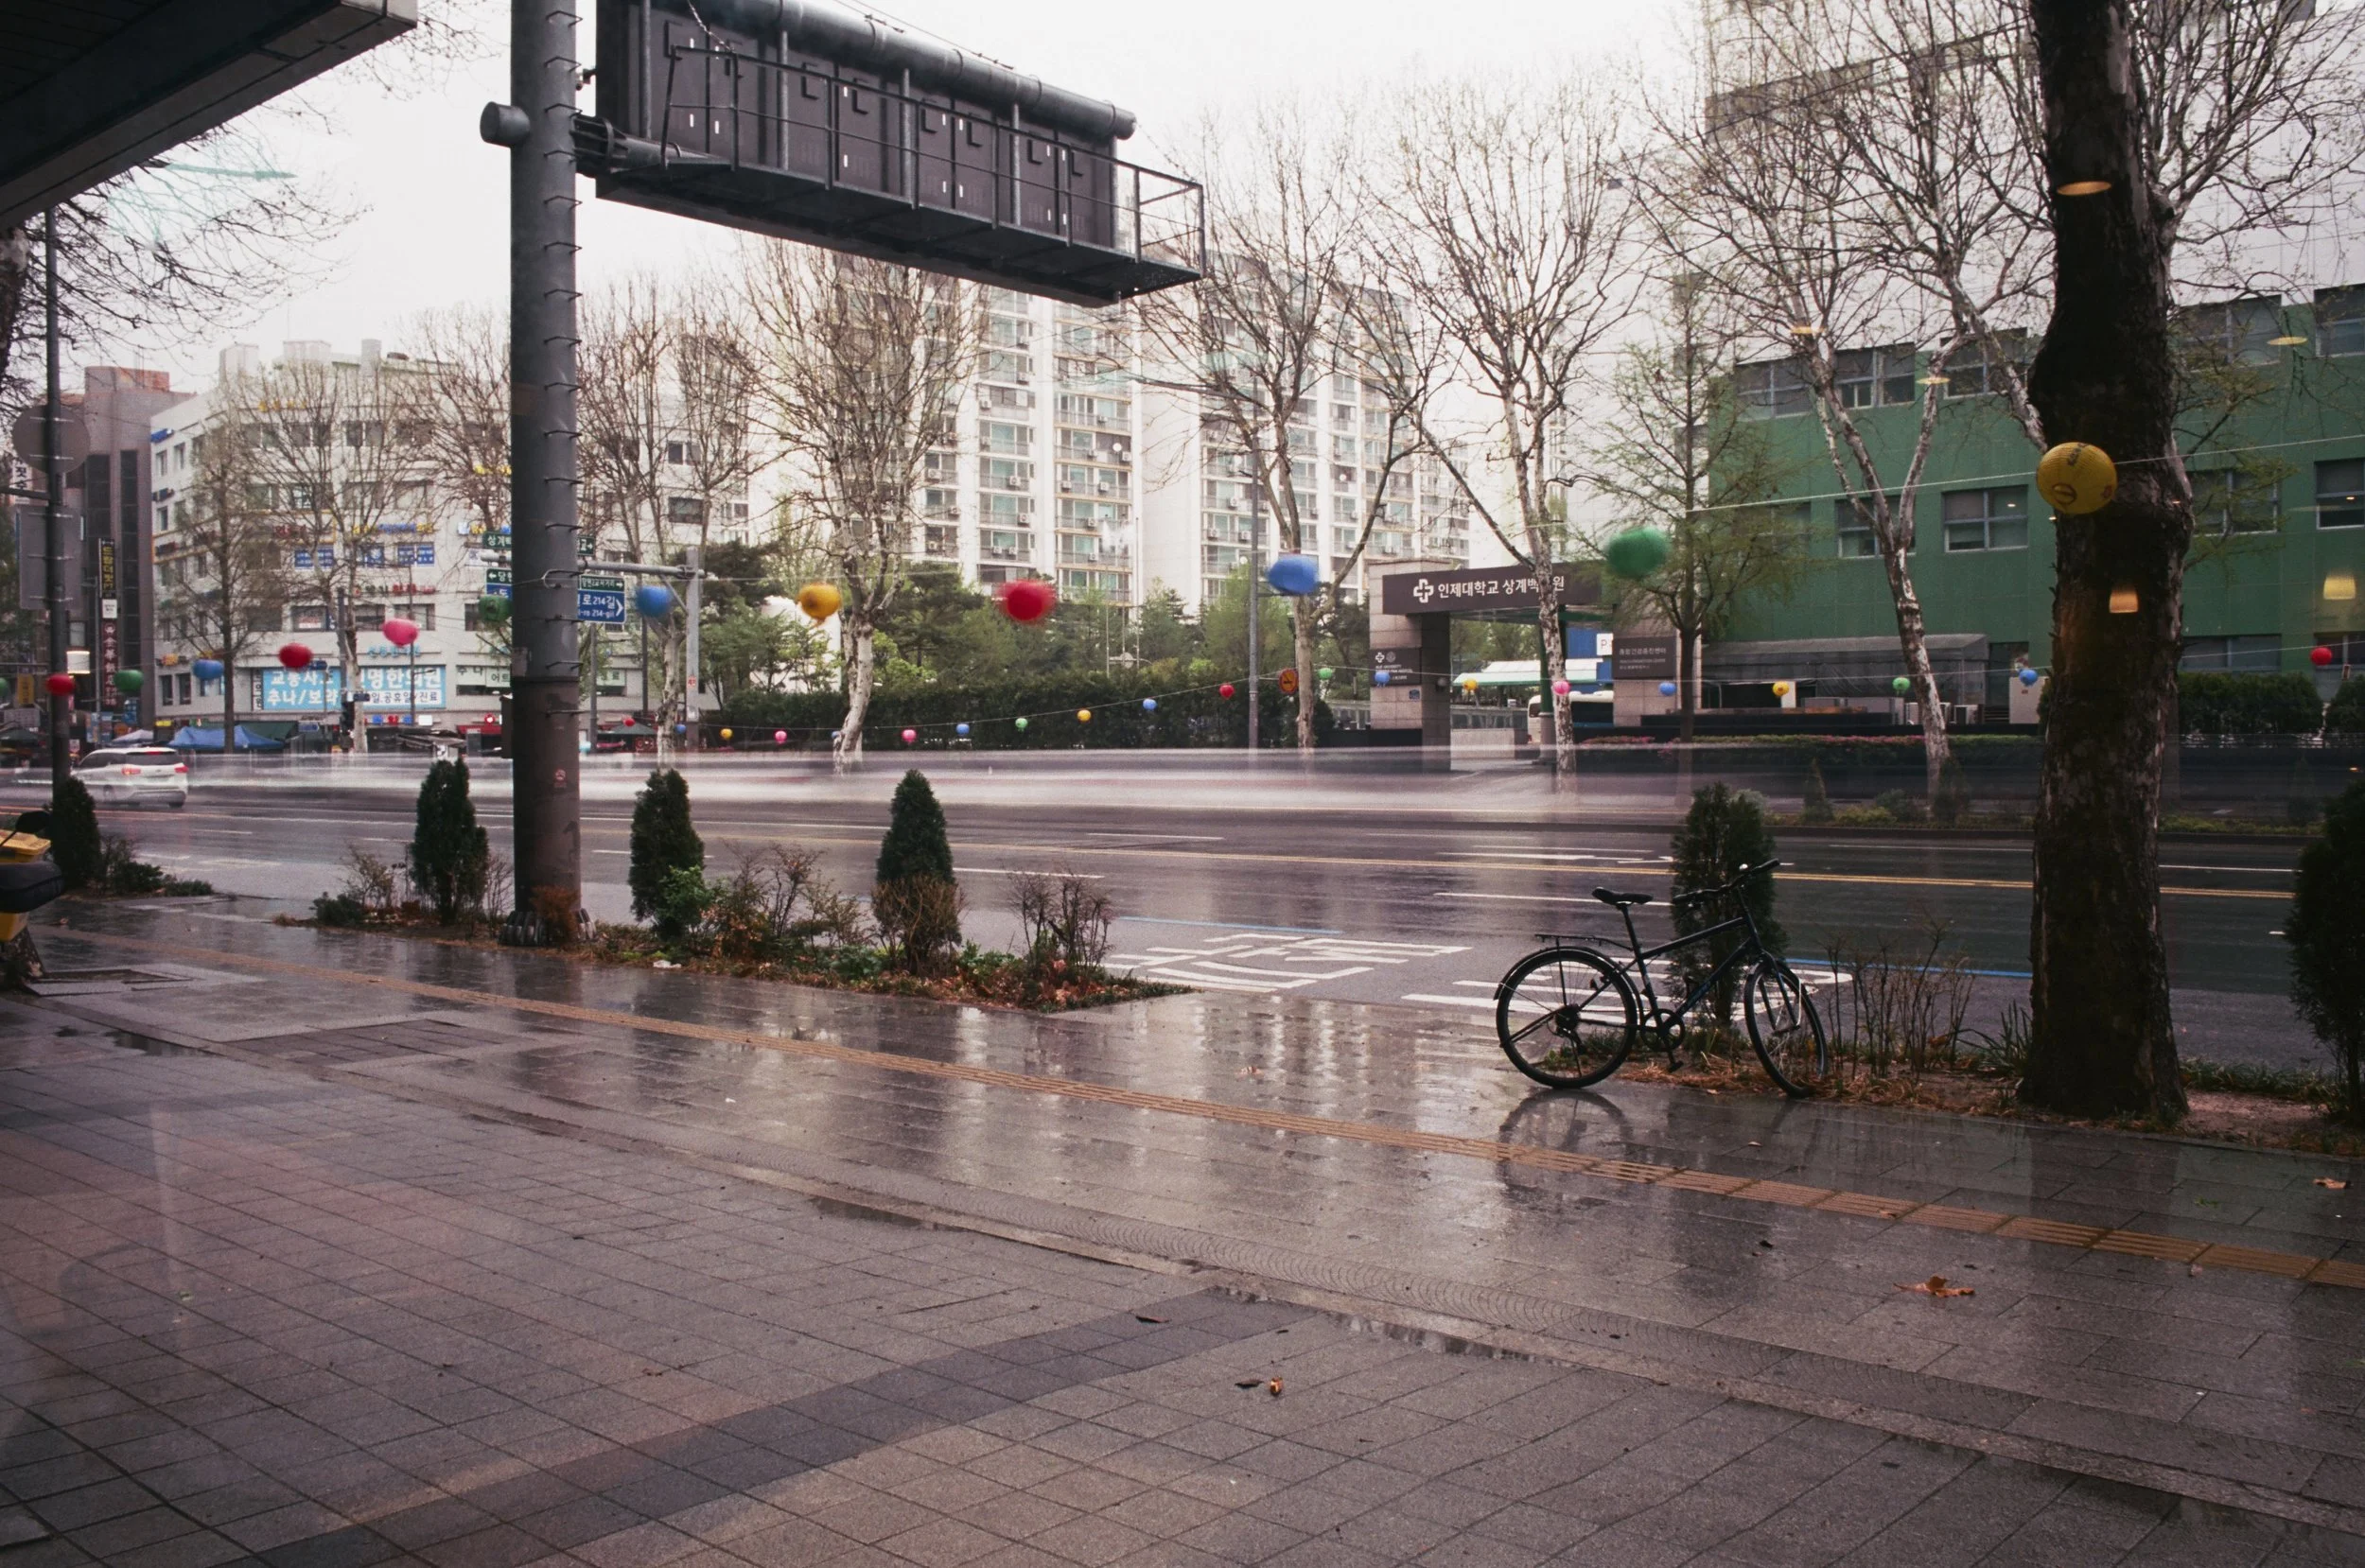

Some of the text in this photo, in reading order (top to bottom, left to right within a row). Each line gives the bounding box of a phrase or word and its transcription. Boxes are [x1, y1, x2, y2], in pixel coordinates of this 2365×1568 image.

[1438, 575, 1565, 599] 인제대학교 상계백원
[360, 667, 442, 689] 명한의원
